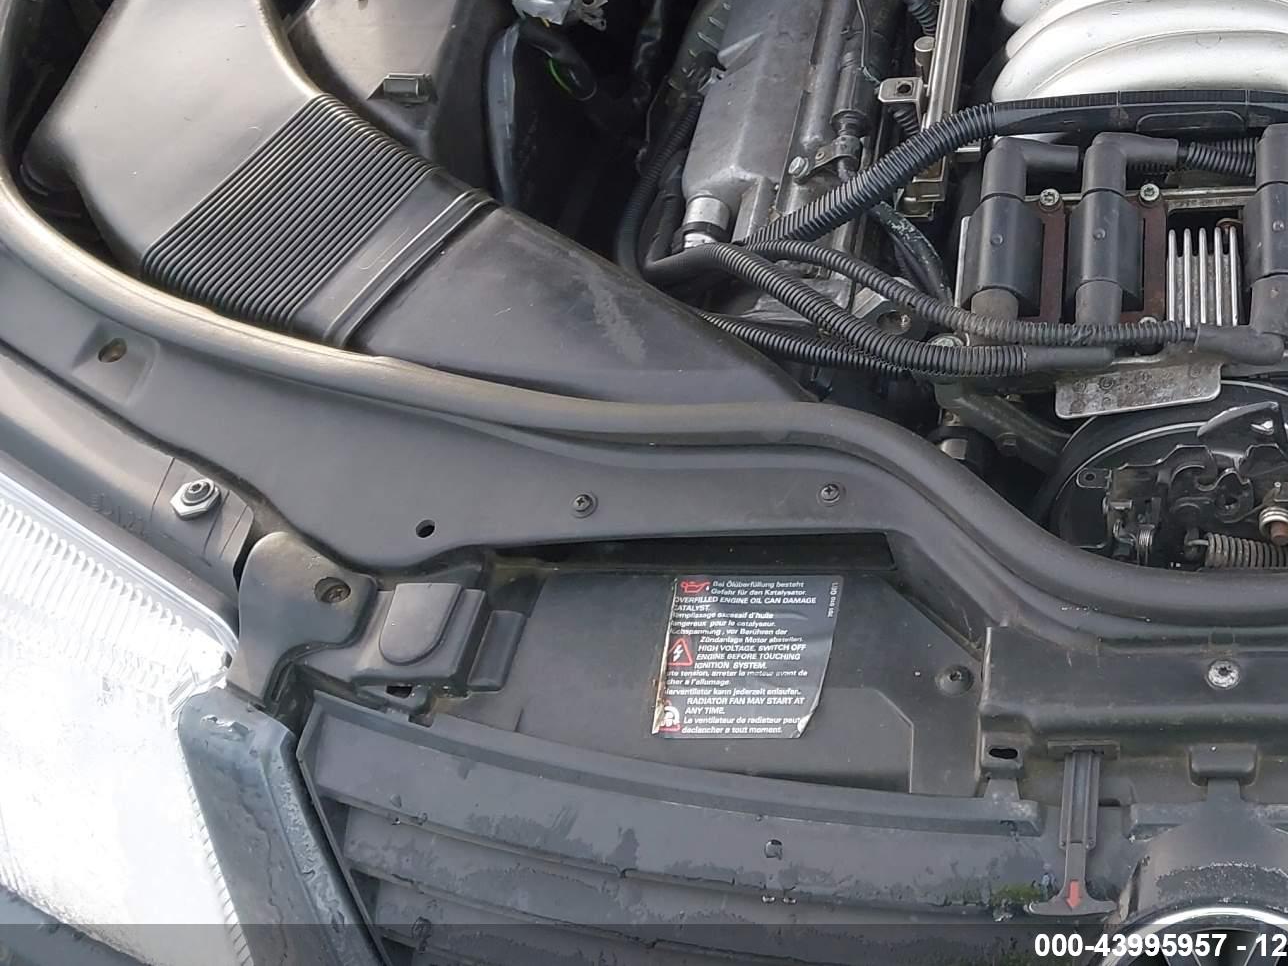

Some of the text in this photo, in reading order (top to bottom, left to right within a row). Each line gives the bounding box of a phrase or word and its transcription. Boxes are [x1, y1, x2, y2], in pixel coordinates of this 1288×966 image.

[720, 596, 749, 604] ENGINE
[750, 596, 762, 604] OIL
[763, 596, 781, 604] CAN
[782, 596, 817, 604] DAMAGE
[710, 620, 727, 628] pour
[728, 620, 735, 628] le
[776, 628, 788, 636] der
[700, 636, 743, 644] Zündanlage
[745, 636, 767, 644] Motor
[697, 644, 718, 652] HIGH
[758, 644, 790, 652] SWITCH
[791, 644, 807, 652] OFF
[696, 653, 801, 661] ENGINE BEFORE TOUCHING
[694, 662, 729, 670] IGNITION
[712, 687, 732, 696] kann
[732, 687, 766, 696] jederzeit
[686, 697, 805, 705] RADIATOR FAN MAY START AT
[684, 707, 702, 715] ANY
[683, 717, 693, 725] Le
[694, 717, 735, 725] ventilateur
[736, 717, 746, 725] de
[747, 717, 782, 725] radiateur
[731, 726, 747, 734] tout
